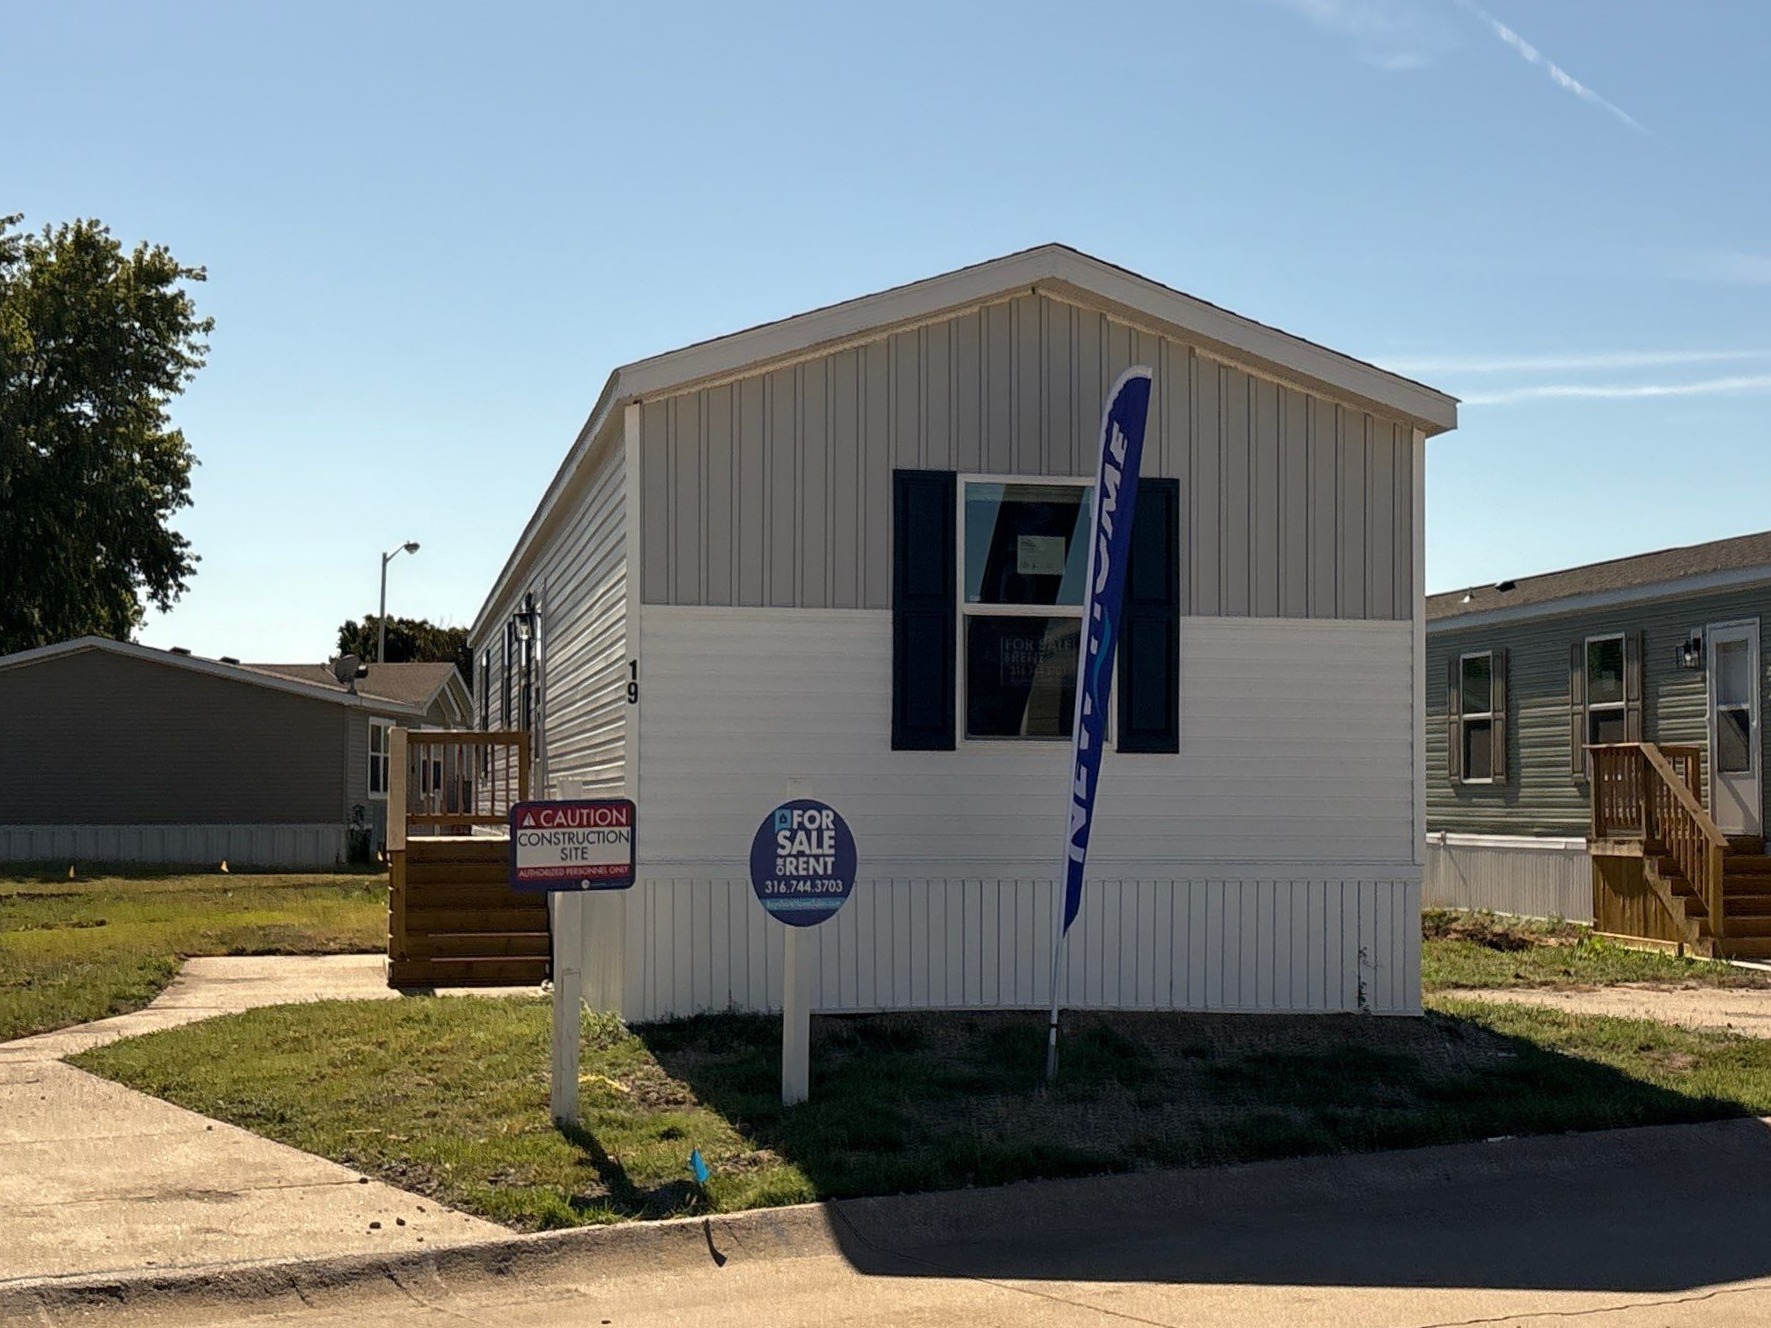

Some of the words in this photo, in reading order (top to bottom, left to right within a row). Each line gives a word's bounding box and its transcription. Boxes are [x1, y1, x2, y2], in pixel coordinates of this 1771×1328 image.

[1005, 638, 1035, 650] FOR
[1039, 637, 1072, 650] SALE
[628, 659, 638, 704] 19
[540, 808, 627, 827] CAUTION
[793, 809, 835, 829] FOR
[518, 830, 630, 847] CONSTRUCTION
[776, 829, 835, 856] SALE
[560, 846, 589, 861] SITE
[518, 867, 565, 878] AUTHORIZED
[566, 866, 608, 876] PERSONNEL
[609, 865, 630, 874] ONLY
[775, 857, 785, 876] OR
[785, 856, 835, 876] RENT
[765, 880, 843, 893] 316.744.3703
